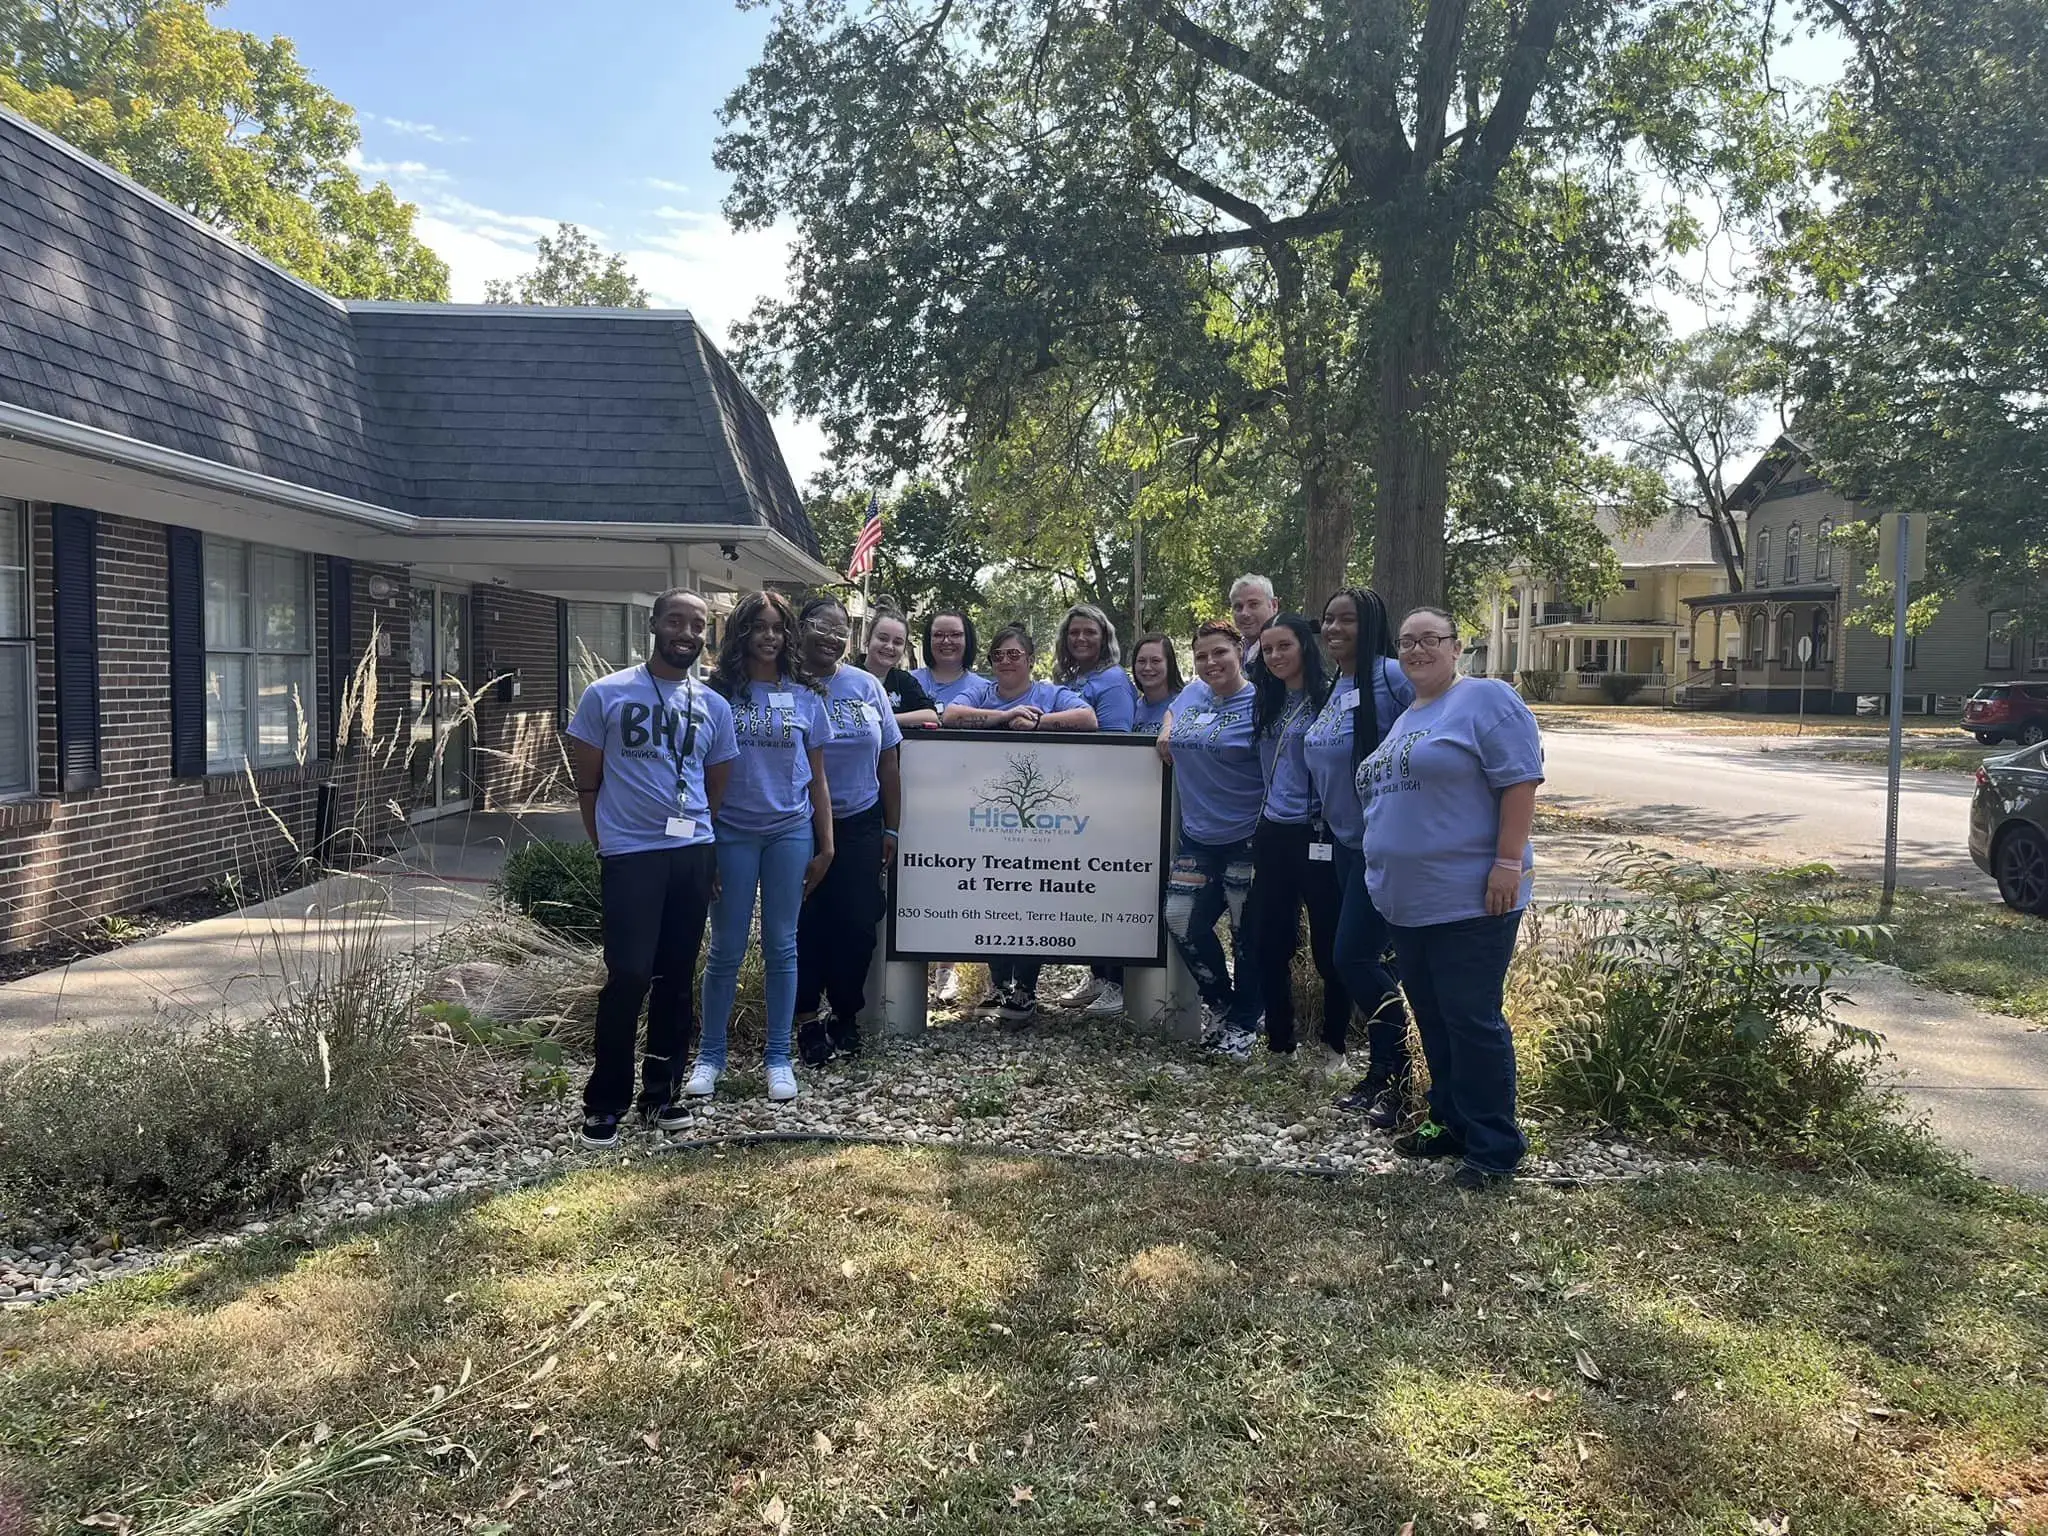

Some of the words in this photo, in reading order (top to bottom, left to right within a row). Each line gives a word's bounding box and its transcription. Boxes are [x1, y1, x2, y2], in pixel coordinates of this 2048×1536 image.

[621, 702, 704, 756] BHT
[969, 807, 1090, 835] Hickory
[969, 827, 1028, 835] TREATMENT
[1032, 827, 1071, 836] CENTER
[903, 853, 976, 872] Hickory
[982, 855, 1081, 871] Treatment
[1087, 857, 1153, 873] Center
[957, 878, 977, 891] at
[983, 877, 1033, 892] Terre
[1039, 878, 1097, 894] Haute
[923, 908, 958, 919] South
[961, 909, 981, 920] 6th
[984, 909, 1022, 922] Street,
[1026, 911, 1057, 921] Terre
[1060, 911, 1097, 924] Haute,
[1101, 913, 1113, 923] IN
[1116, 913, 1154, 924] 47807
[974, 934, 1076, 948] 812.213.8080
